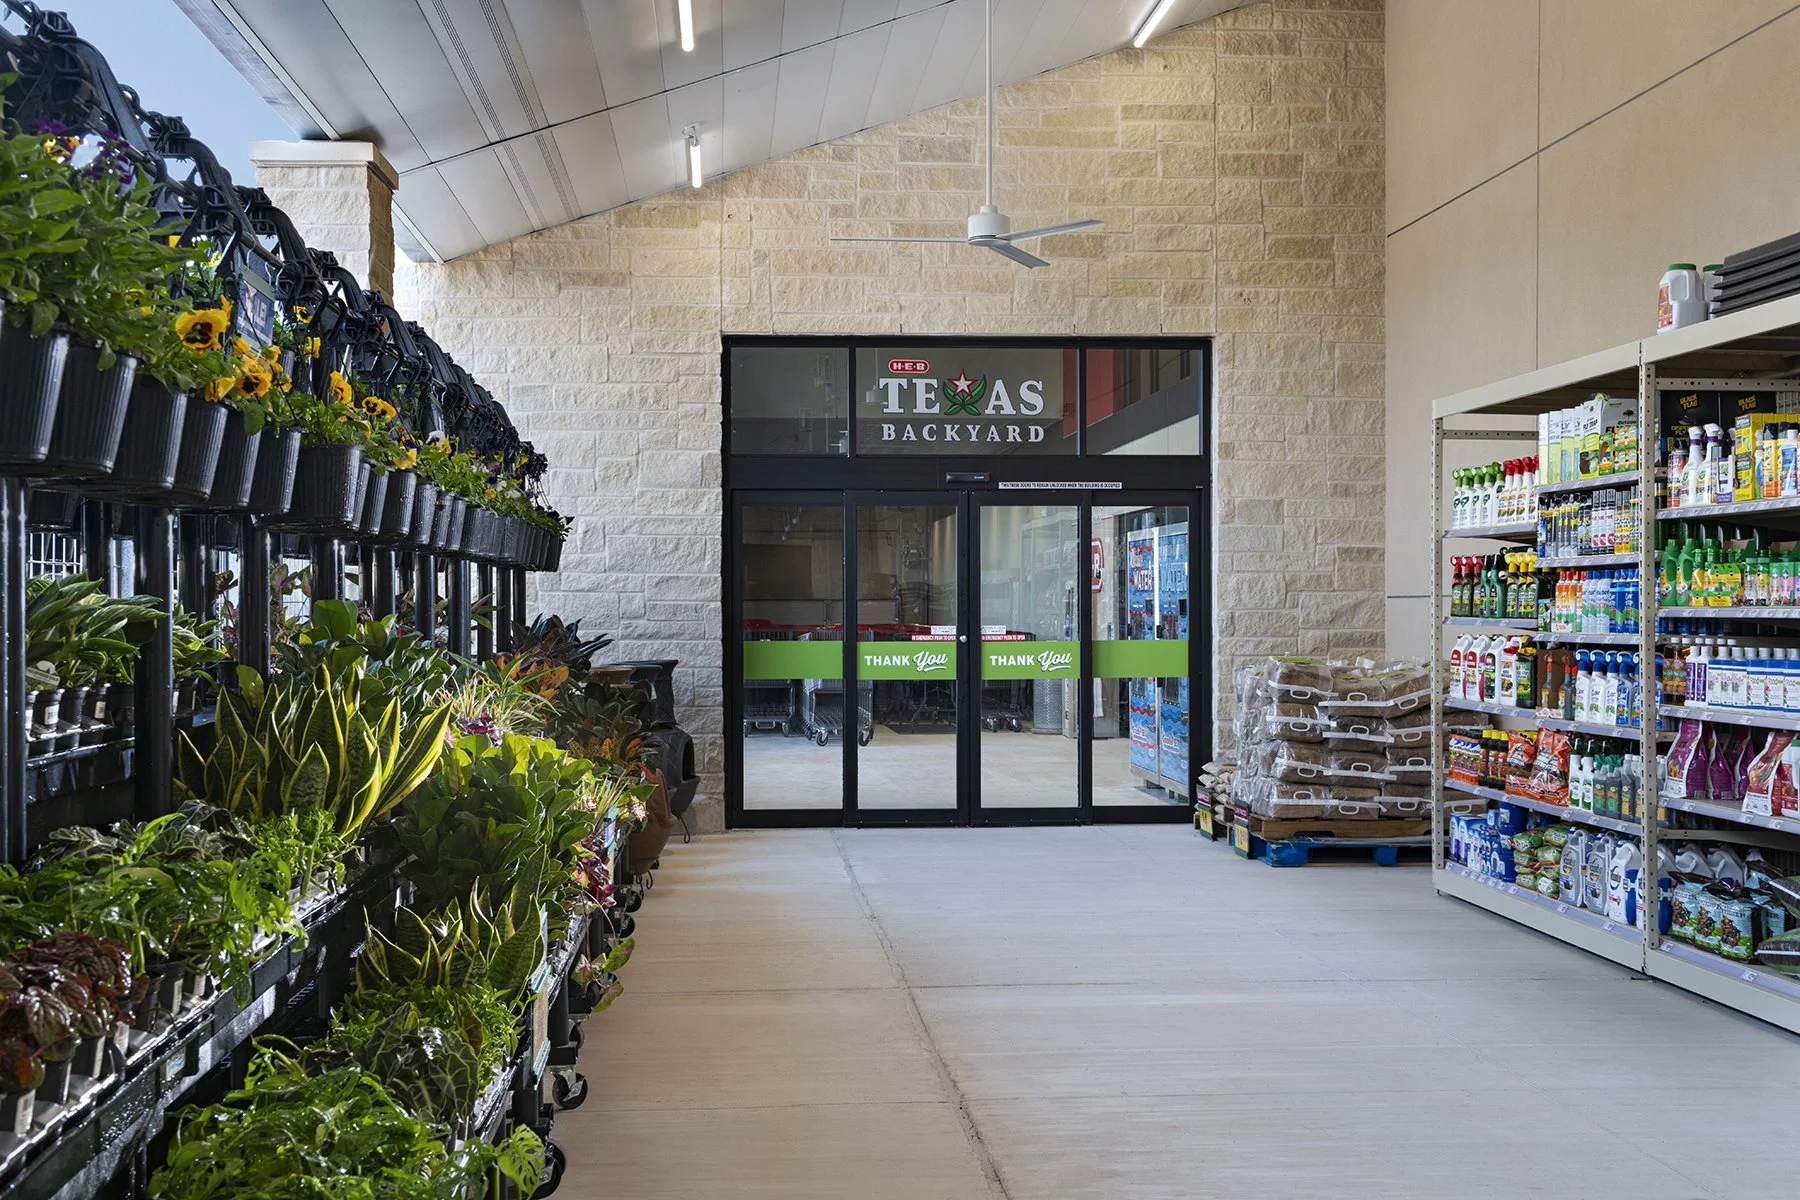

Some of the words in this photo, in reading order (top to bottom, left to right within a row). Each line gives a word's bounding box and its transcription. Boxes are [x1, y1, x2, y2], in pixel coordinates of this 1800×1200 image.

[1680, 393, 1698, 405] BLACK
[1737, 395, 1756, 407] BLACK
[1683, 401, 1698, 410] FLAG
[1741, 402, 1757, 411] FLAG
[881, 423, 1045, 443] BACKYARD
[864, 655, 910, 666] THANK
[912, 651, 948, 672] You
[990, 655, 1035, 666] THANK
[1037, 651, 1073, 672] You
